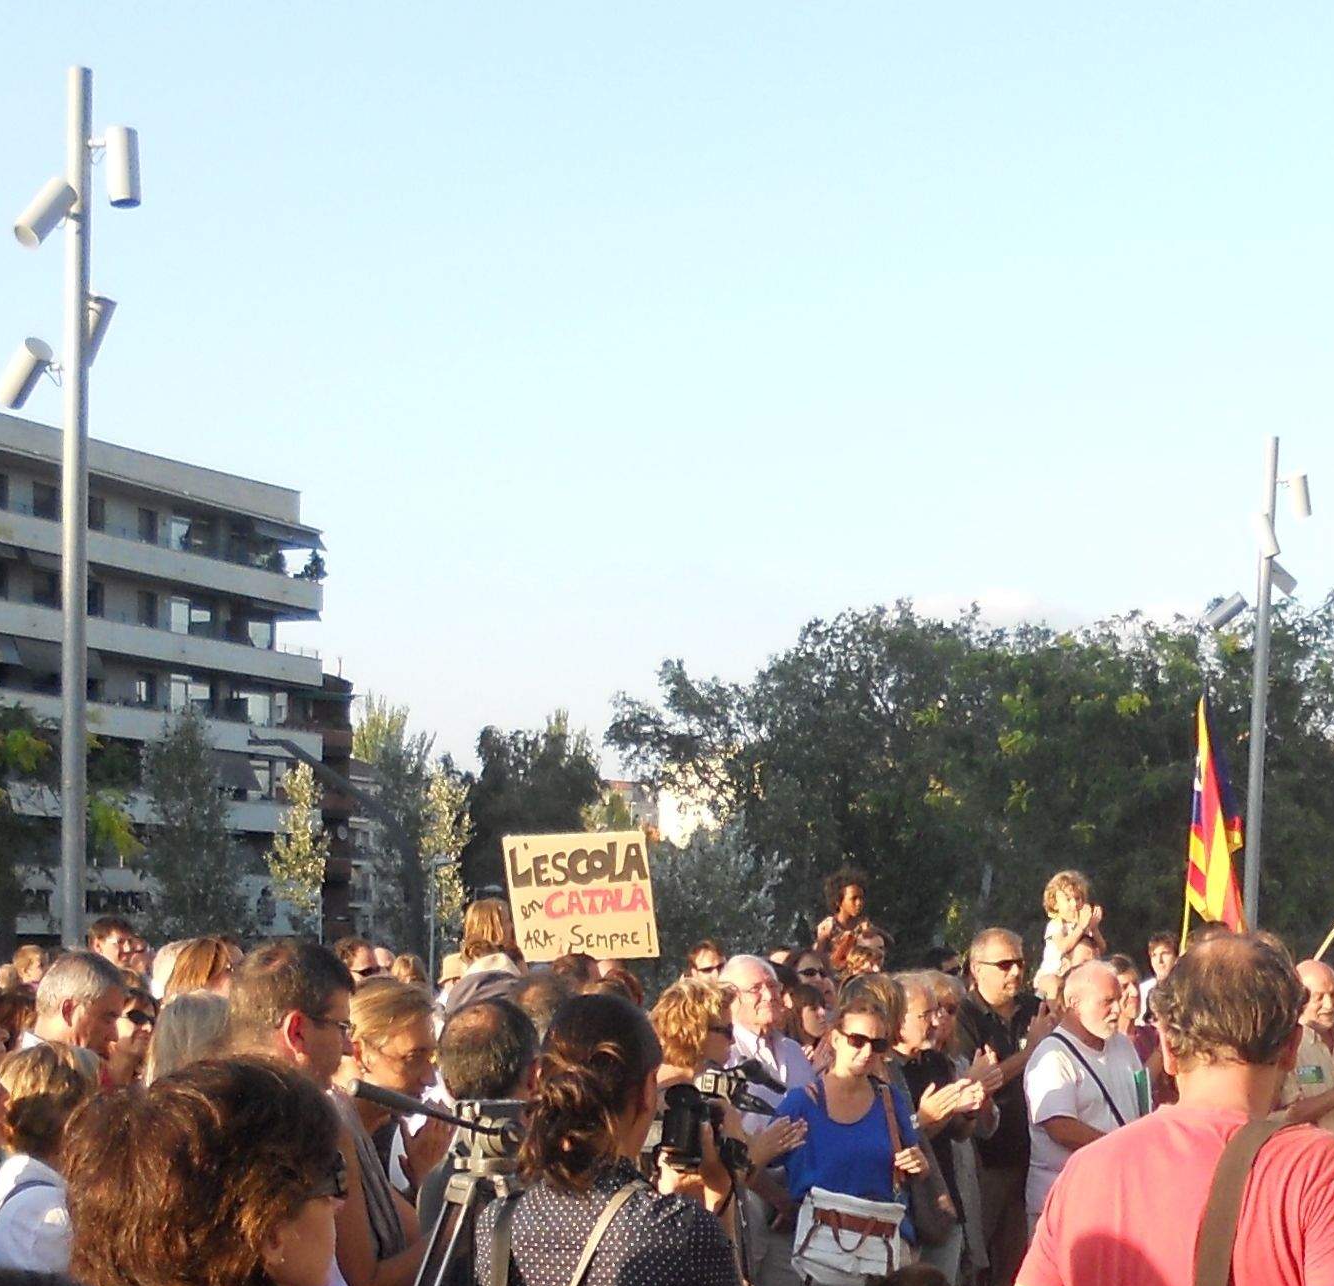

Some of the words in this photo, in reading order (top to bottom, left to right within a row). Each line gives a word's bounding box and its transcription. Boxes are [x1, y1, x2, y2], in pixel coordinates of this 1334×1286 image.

[508, 841, 649, 888] L'ESCOLA
[544, 883, 650, 919] CATALÀ
[524, 929, 555, 950] ARA
